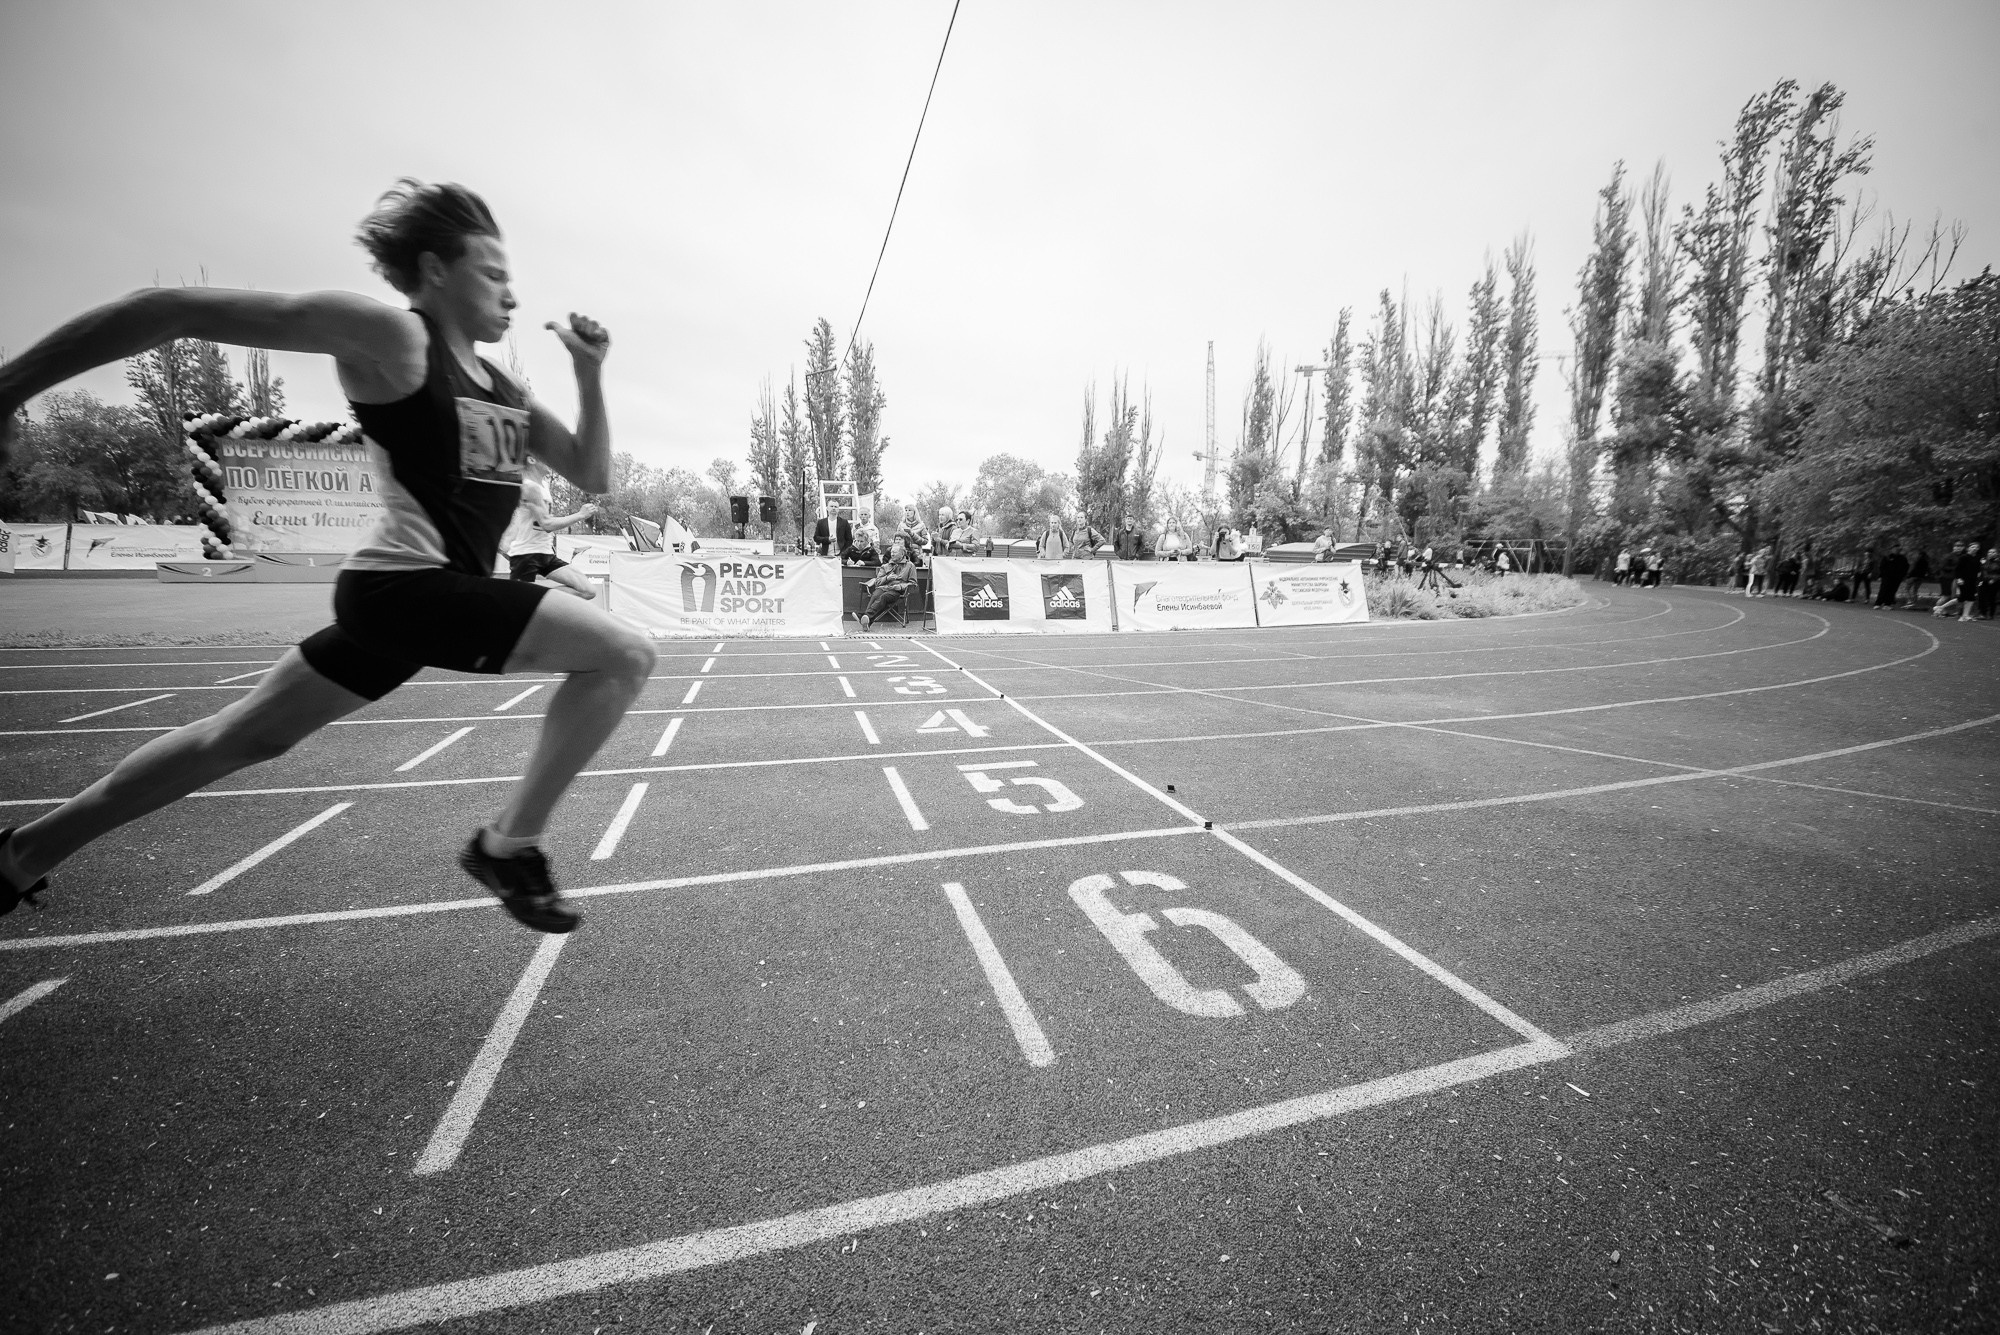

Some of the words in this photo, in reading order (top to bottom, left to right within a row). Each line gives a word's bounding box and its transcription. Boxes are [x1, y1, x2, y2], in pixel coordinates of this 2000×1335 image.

[227, 467, 258, 490] ПО
[265, 466, 349, 492] ЛЁГКОЙ
[252, 511, 307, 527] Елены
[308, 558, 316, 567] 1
[202, 567, 213, 577] 2
[719, 562, 785, 580] PEACE
[720, 580, 767, 596] AND
[720, 597, 785, 613] SPORT
[968, 598, 1003, 608] adidas
[1049, 599, 1081, 608] adidas
[1156, 603, 1180, 611] Елены
[1181, 602, 1223, 611] Исинбаевой
[680, 617, 691, 625] BE
[692, 617, 712, 625] PART
[713, 617, 726, 626] OF
[727, 617, 750, 625] WHAT
[752, 618, 786, 626] MATTERS
[866, 655, 920, 667] 2
[886, 675, 948, 695] 3
[916, 708, 991, 738] 4
[956, 760, 1085, 815] 5
[1067, 870, 1306, 1019] 6
